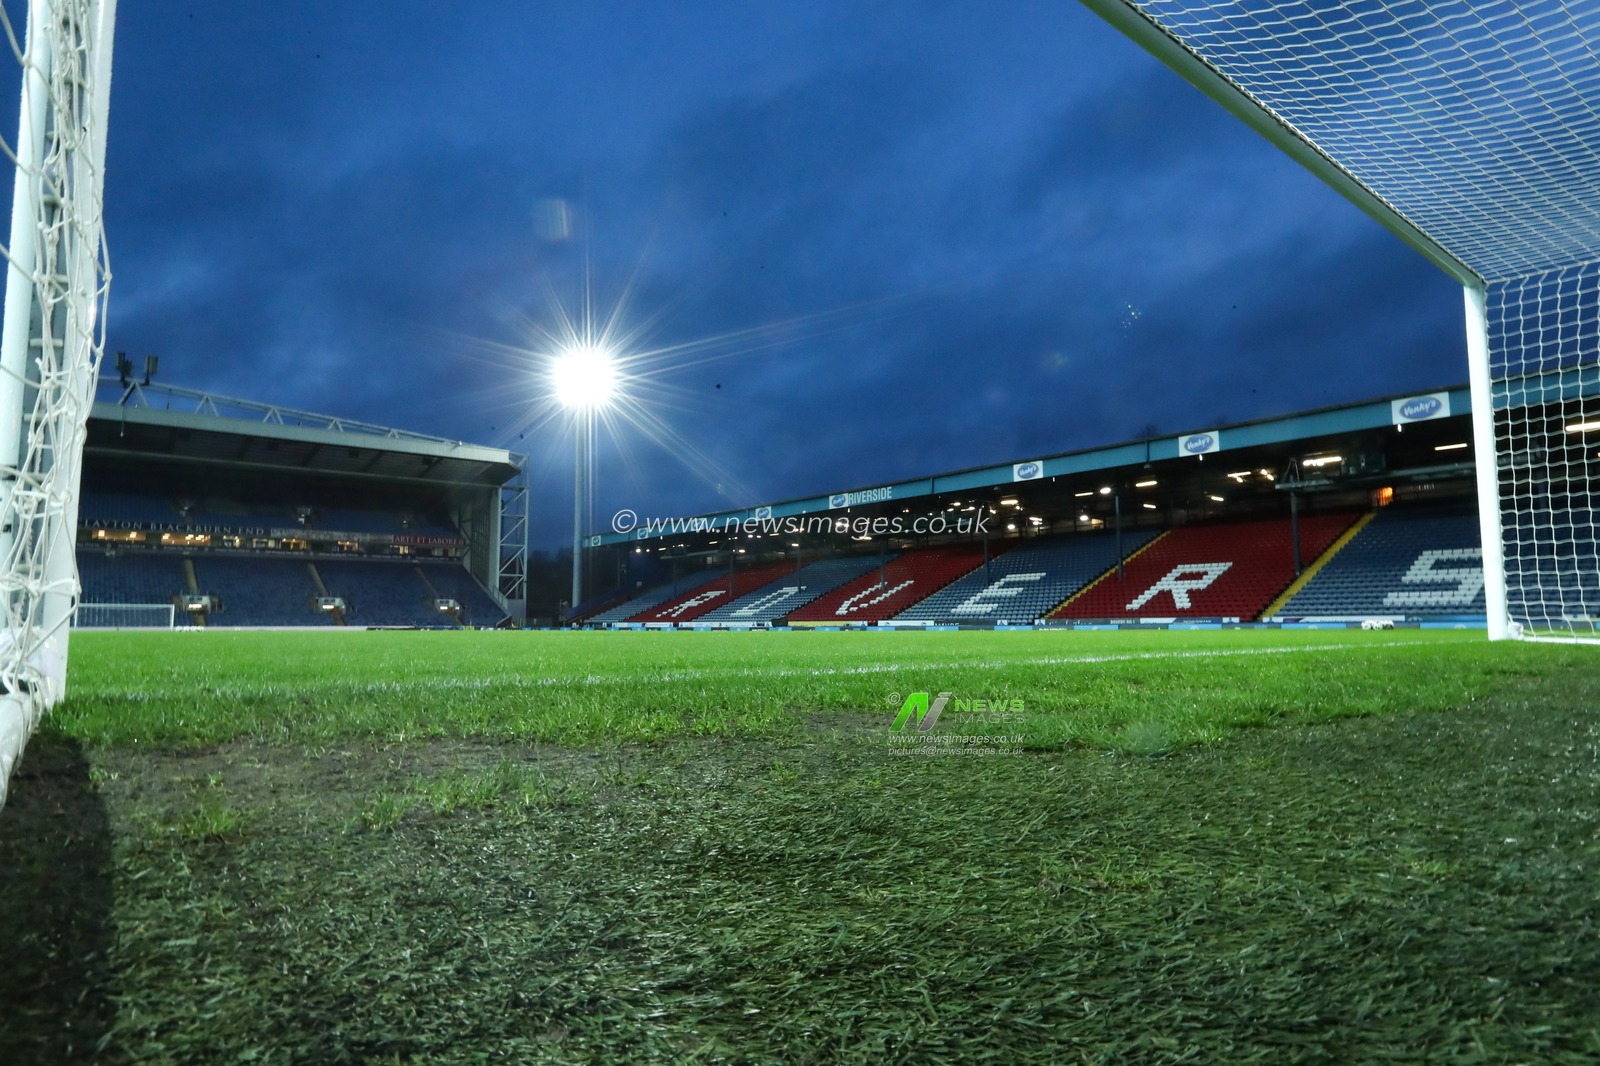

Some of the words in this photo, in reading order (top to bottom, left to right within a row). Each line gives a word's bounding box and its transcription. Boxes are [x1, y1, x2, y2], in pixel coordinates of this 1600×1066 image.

[1403, 399, 1438, 417] Venky's
[848, 486, 893, 505] RIVERSIDE
[150, 523, 232, 535] BLACKBURN
[238, 527, 265, 536] END
